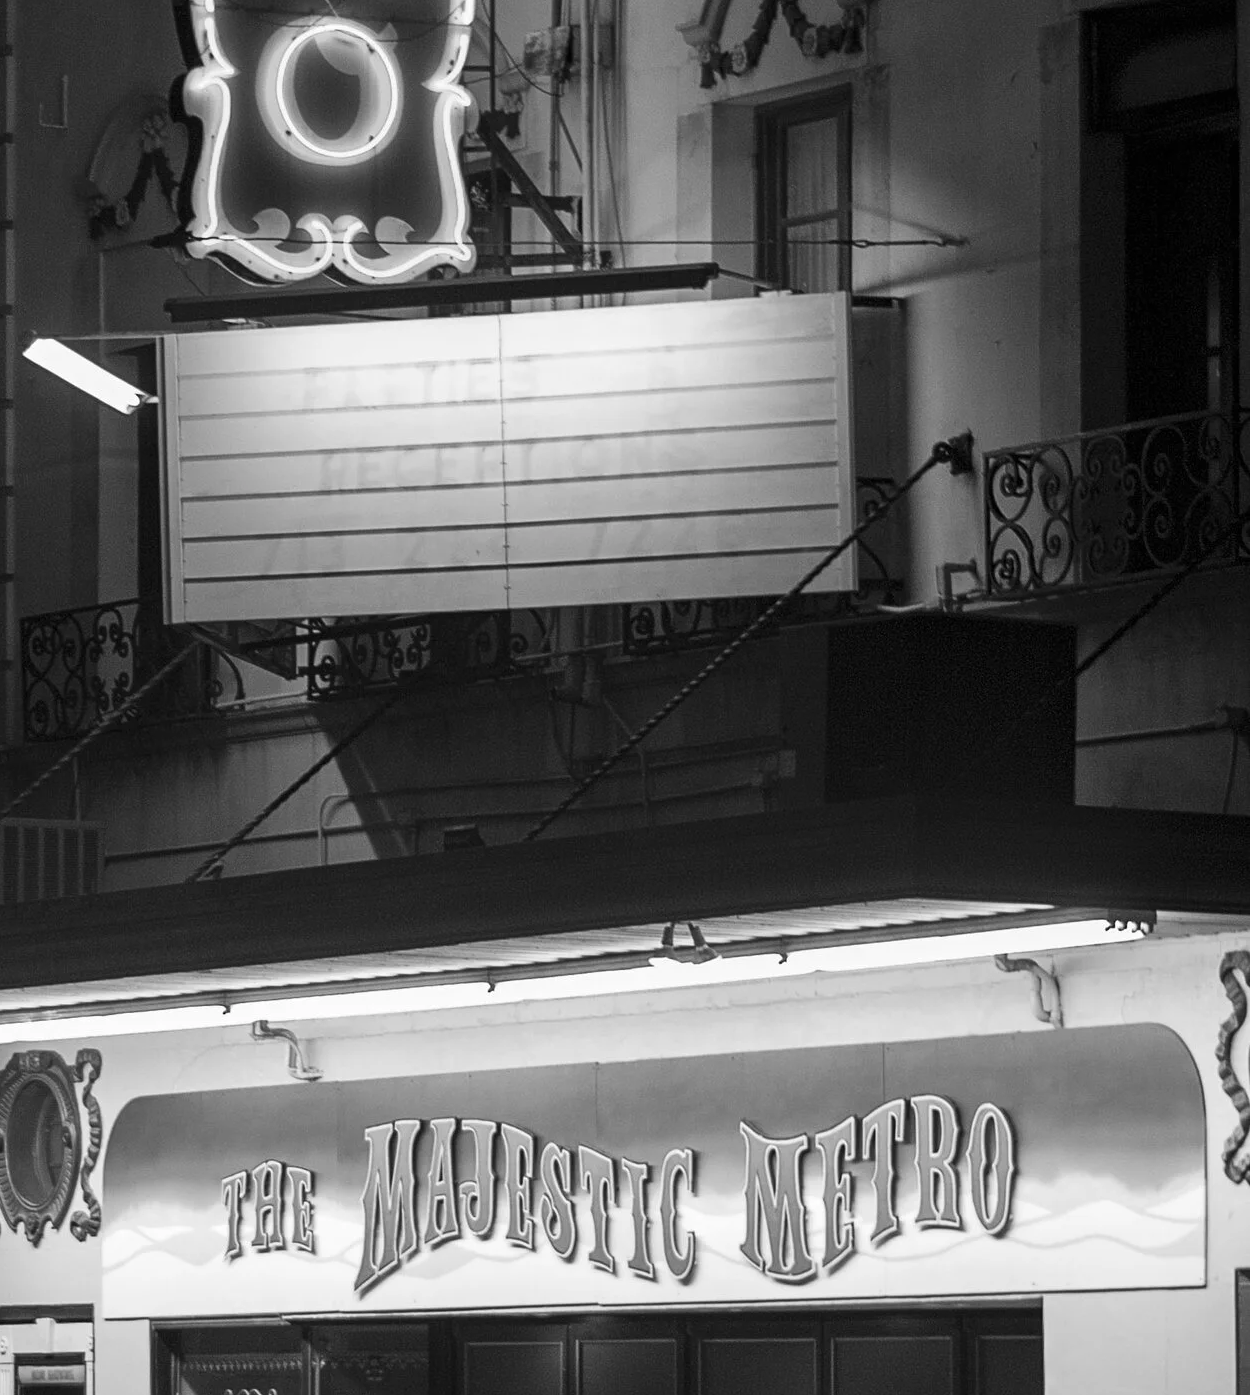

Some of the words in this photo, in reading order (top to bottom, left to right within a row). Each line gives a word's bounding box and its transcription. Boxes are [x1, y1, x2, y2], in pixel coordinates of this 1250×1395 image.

[221, 1158, 319, 1262] THE
[353, 1115, 698, 1297] MAJESTIC
[737, 1092, 1017, 1287] METRO
